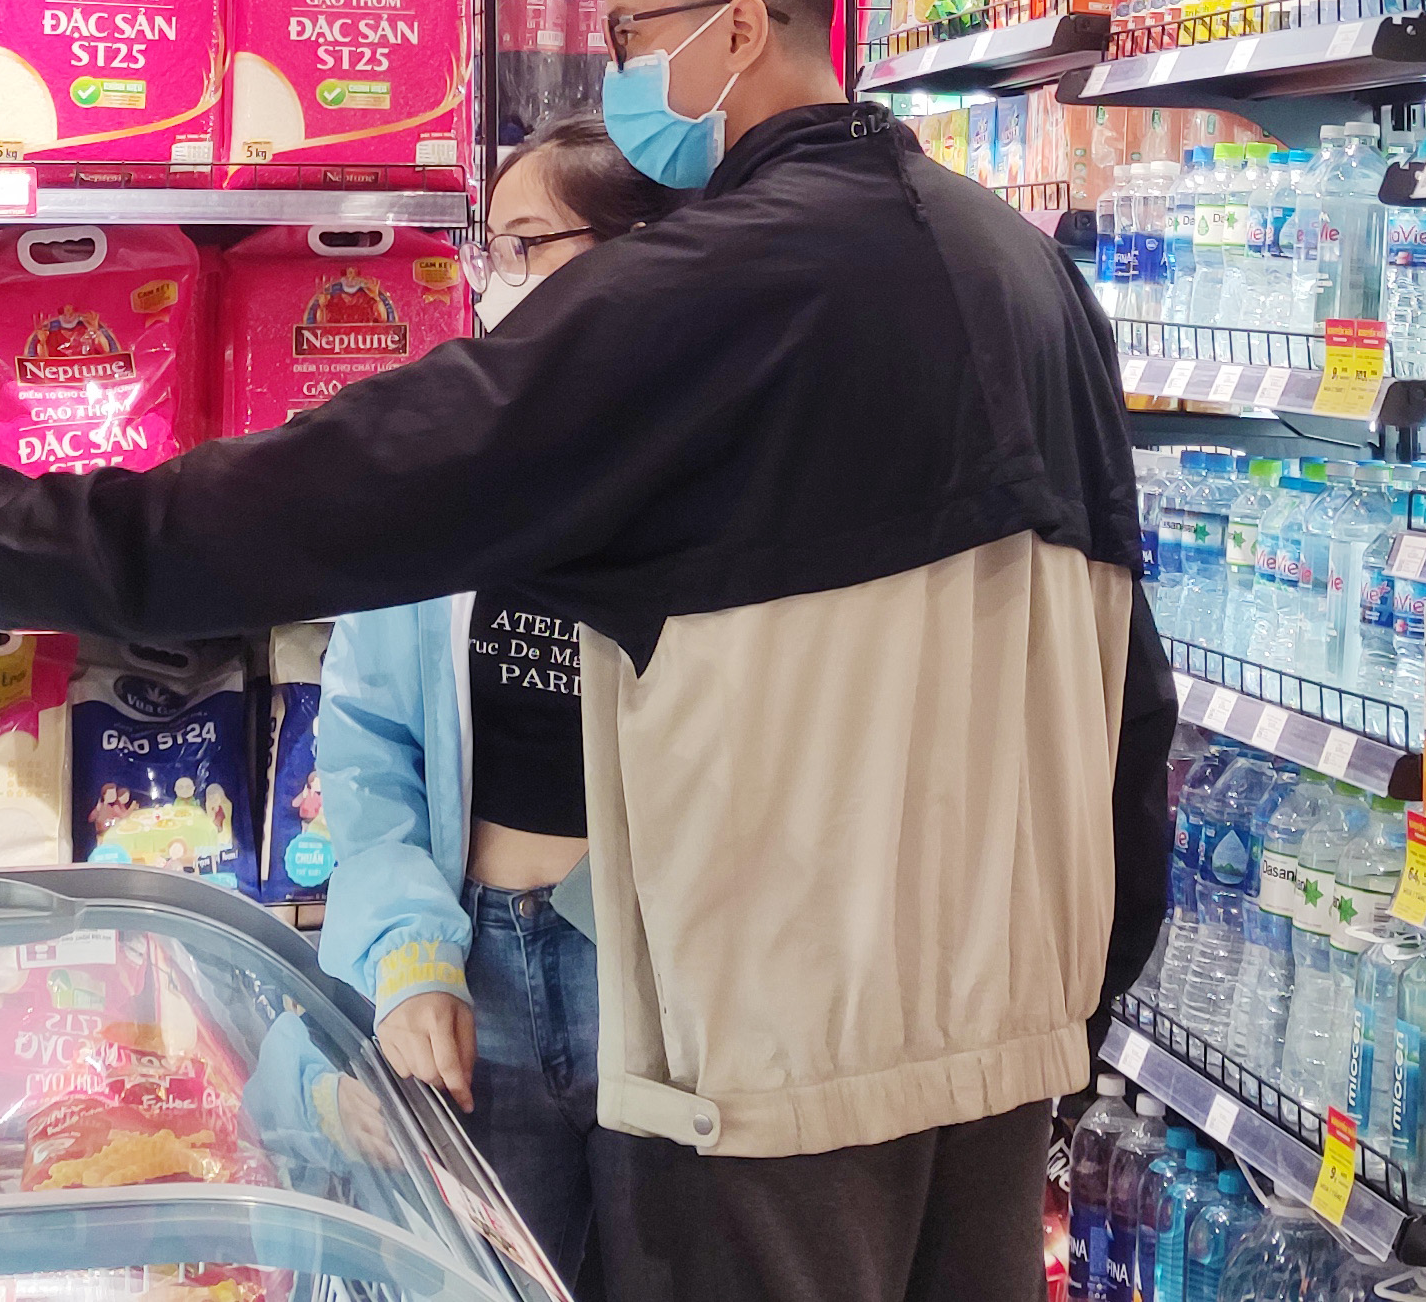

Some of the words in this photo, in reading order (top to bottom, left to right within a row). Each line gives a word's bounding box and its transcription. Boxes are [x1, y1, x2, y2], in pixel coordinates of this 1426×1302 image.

[42, 8, 108, 39] ĐẶC
[114, 8, 176, 41] SẢN
[288, 15, 352, 43] ĐẶC
[359, 14, 419, 45] SẢN
[71, 42, 146, 69] ST25
[317, 46, 390, 71] ST25
[301, 330, 400, 353] Neptune
[23, 360, 126, 381] Neptune
[31, 406, 71, 423] GẠO
[19, 431, 82, 464] ĐẶC
[491, 609, 581, 643] ATELI
[509, 640, 540, 660] De
[499, 663, 582, 696] PARI
[157, 721, 217, 750] ST24
[1392, 1033, 1406, 1132] miocen
